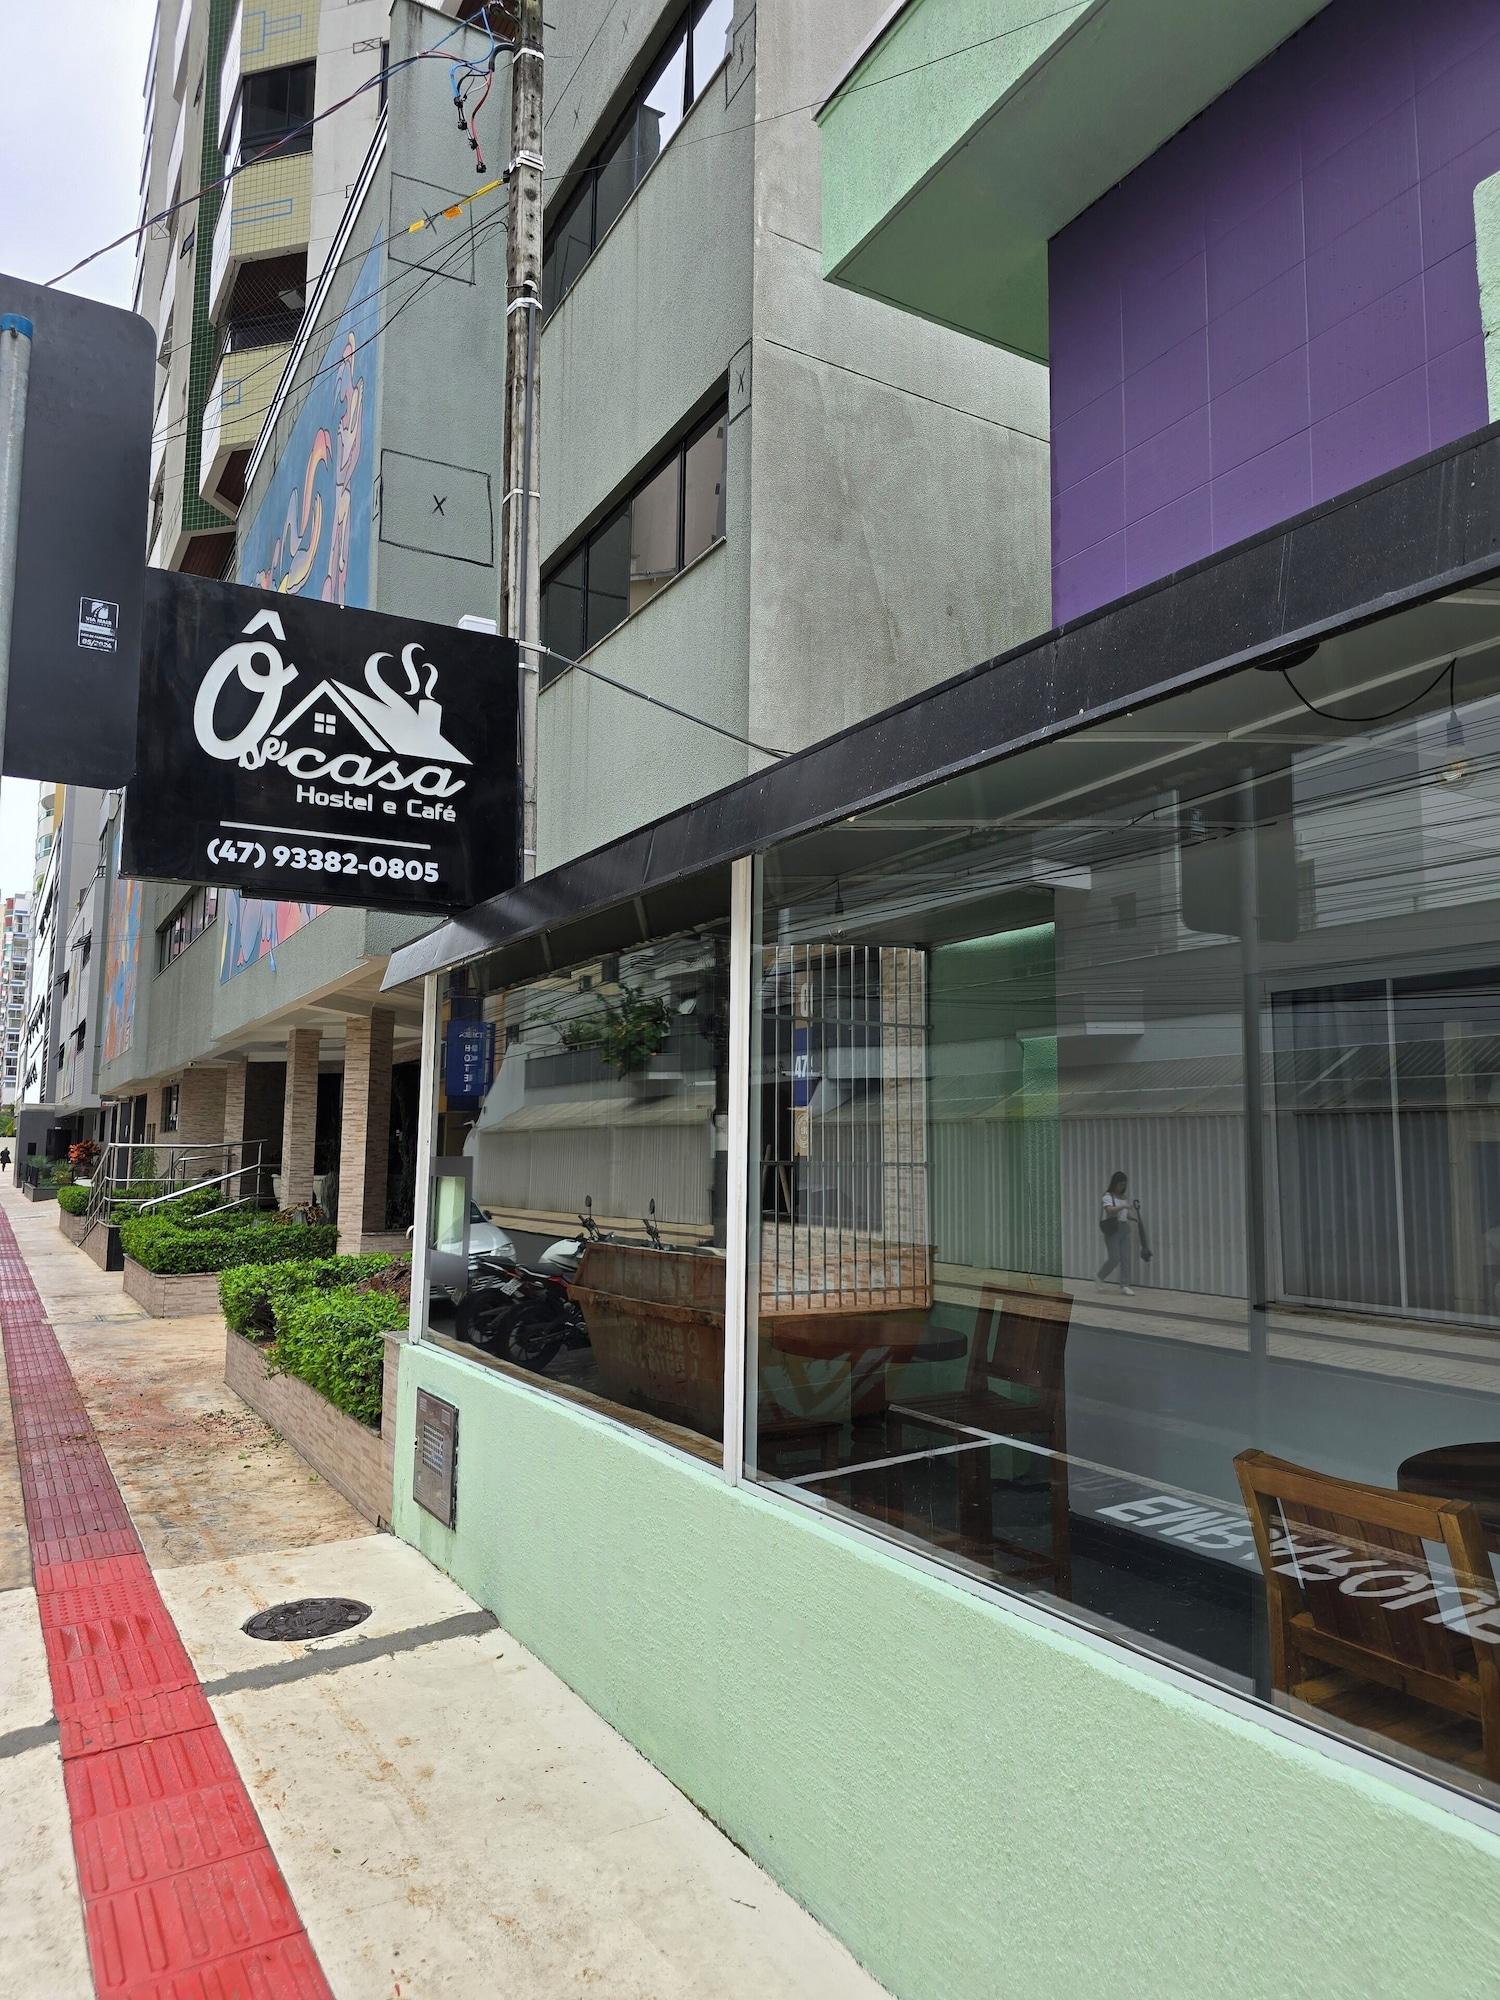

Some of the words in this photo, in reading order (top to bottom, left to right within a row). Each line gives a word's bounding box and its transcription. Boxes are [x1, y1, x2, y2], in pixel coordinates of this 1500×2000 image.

[277, 747, 466, 798] casa
[296, 784, 373, 812] Hostel
[382, 801, 397, 815] e
[406, 799, 457, 823] Café
[206, 837, 267, 869] (47)
[272, 845, 440, 883] 93382-0805
